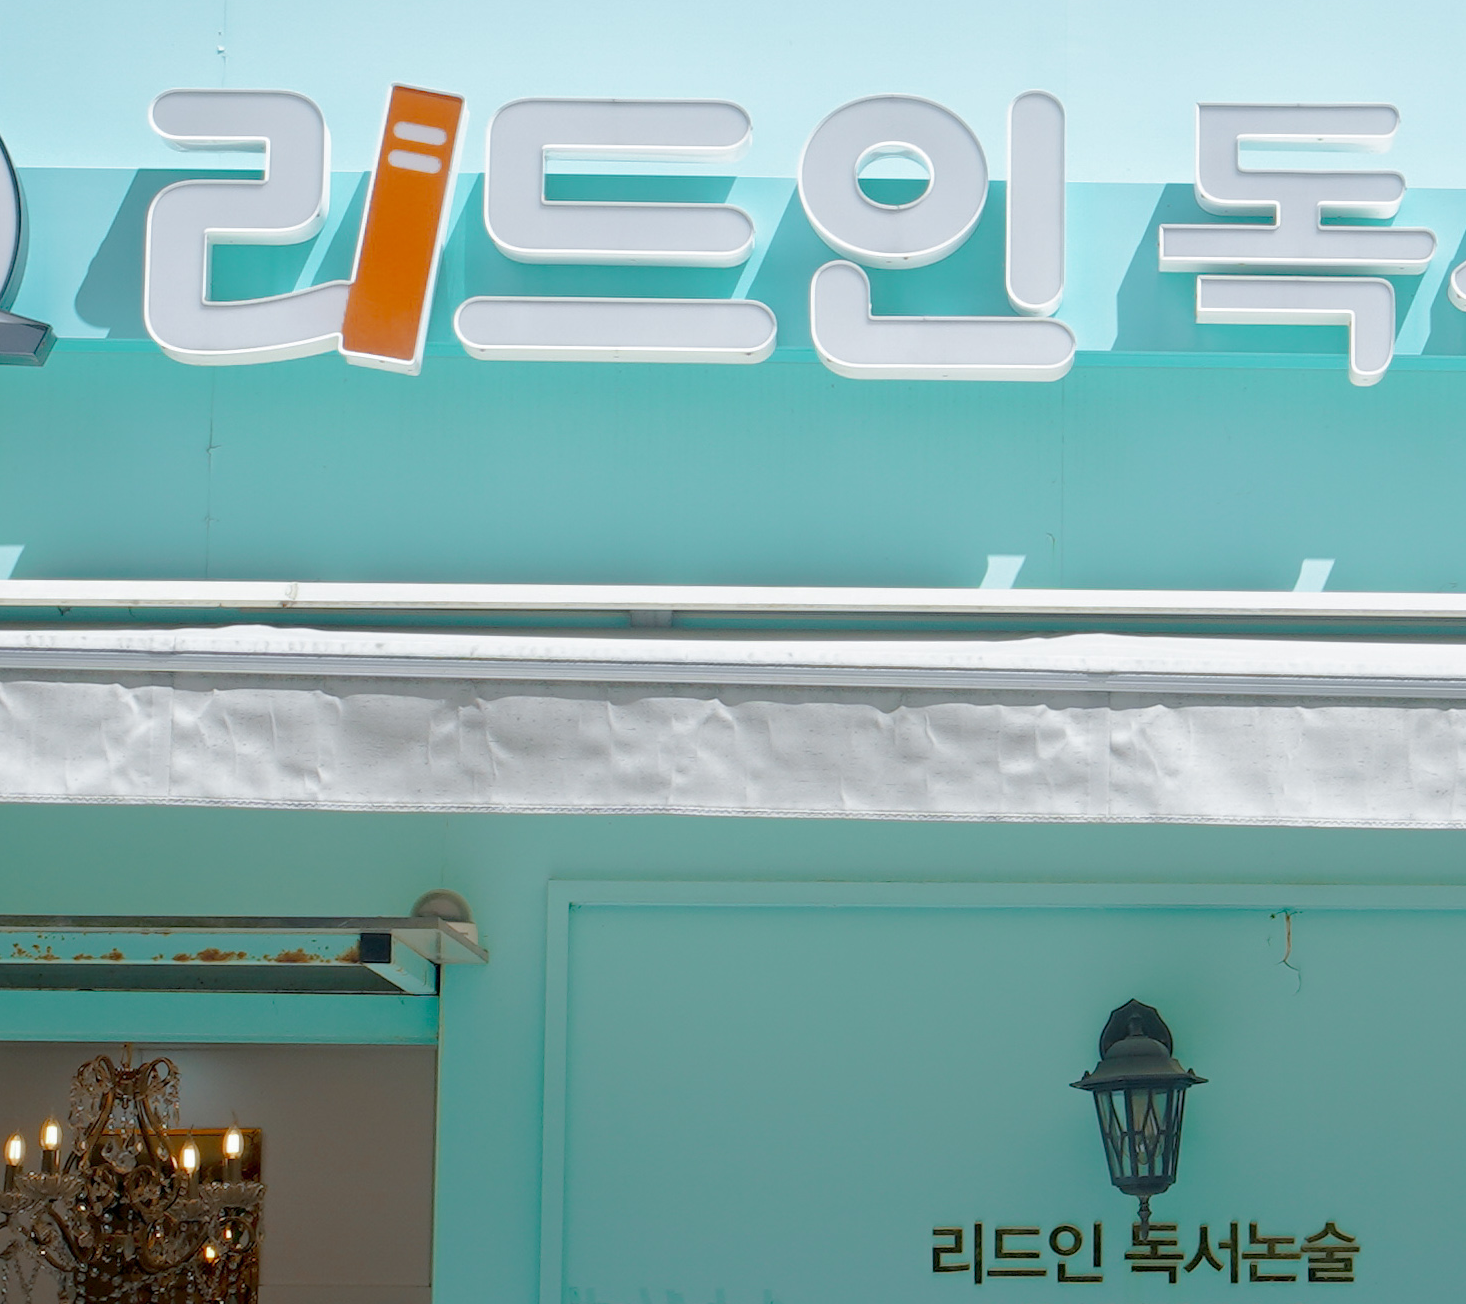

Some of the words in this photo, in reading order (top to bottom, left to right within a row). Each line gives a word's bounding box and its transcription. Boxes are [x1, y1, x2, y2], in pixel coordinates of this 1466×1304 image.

[145, 85, 1078, 381] 리드인
[932, 1221, 1103, 1284] 리드인
[1124, 1221, 1360, 1284] 독서논술
